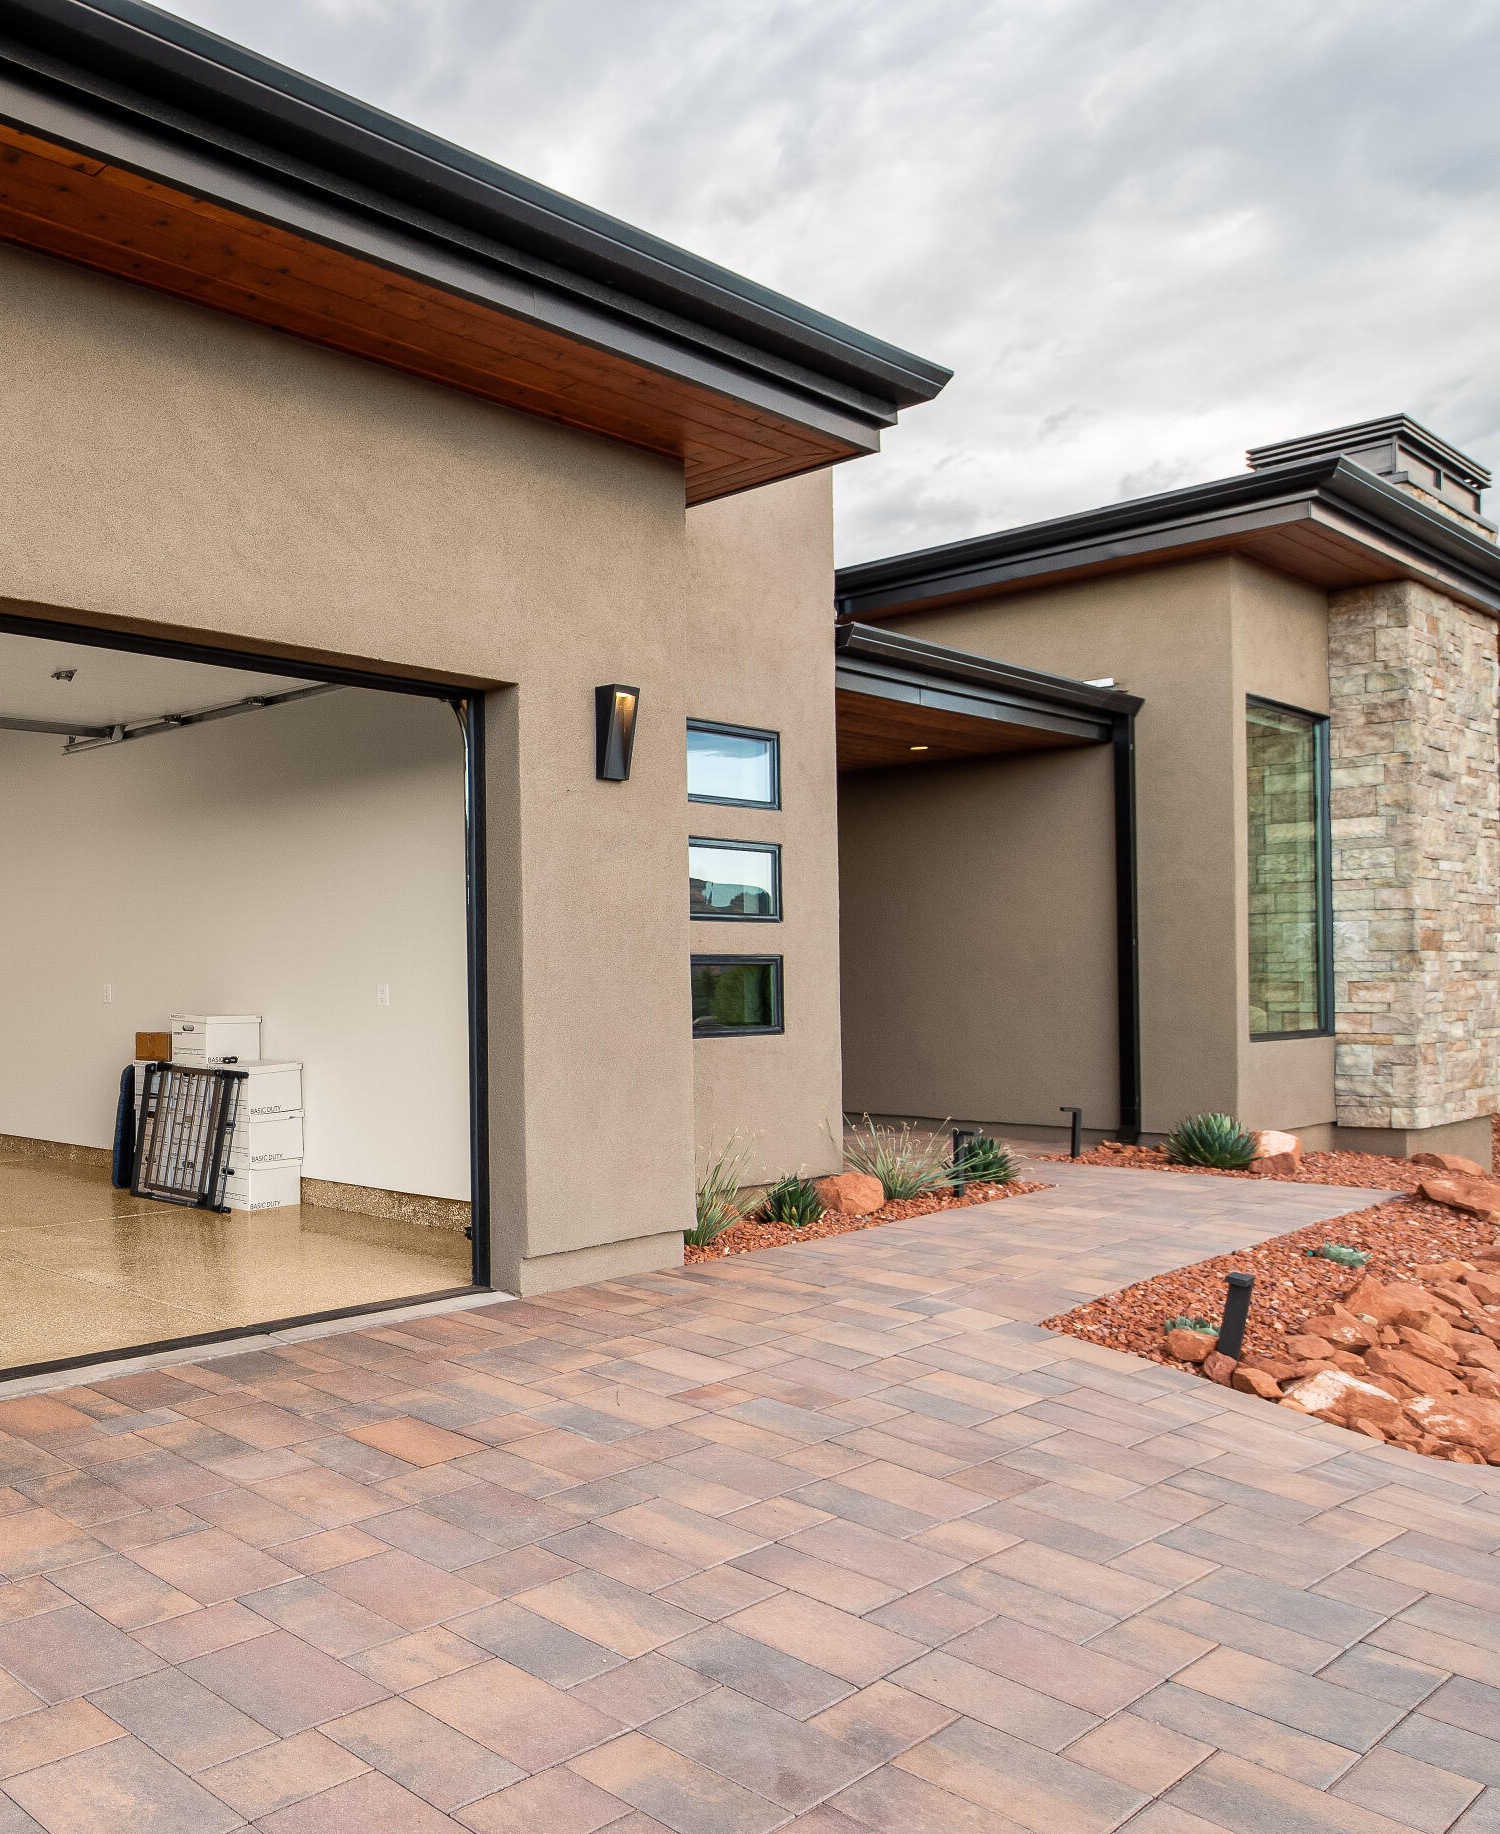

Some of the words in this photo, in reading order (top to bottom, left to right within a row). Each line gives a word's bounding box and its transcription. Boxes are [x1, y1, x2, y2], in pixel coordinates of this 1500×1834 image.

[250, 1107, 266, 1115] BASIC
[266, 1105, 282, 1113] DUTY
[251, 1155, 268, 1163] BASIC
[250, 1202, 266, 1210] BASIC
